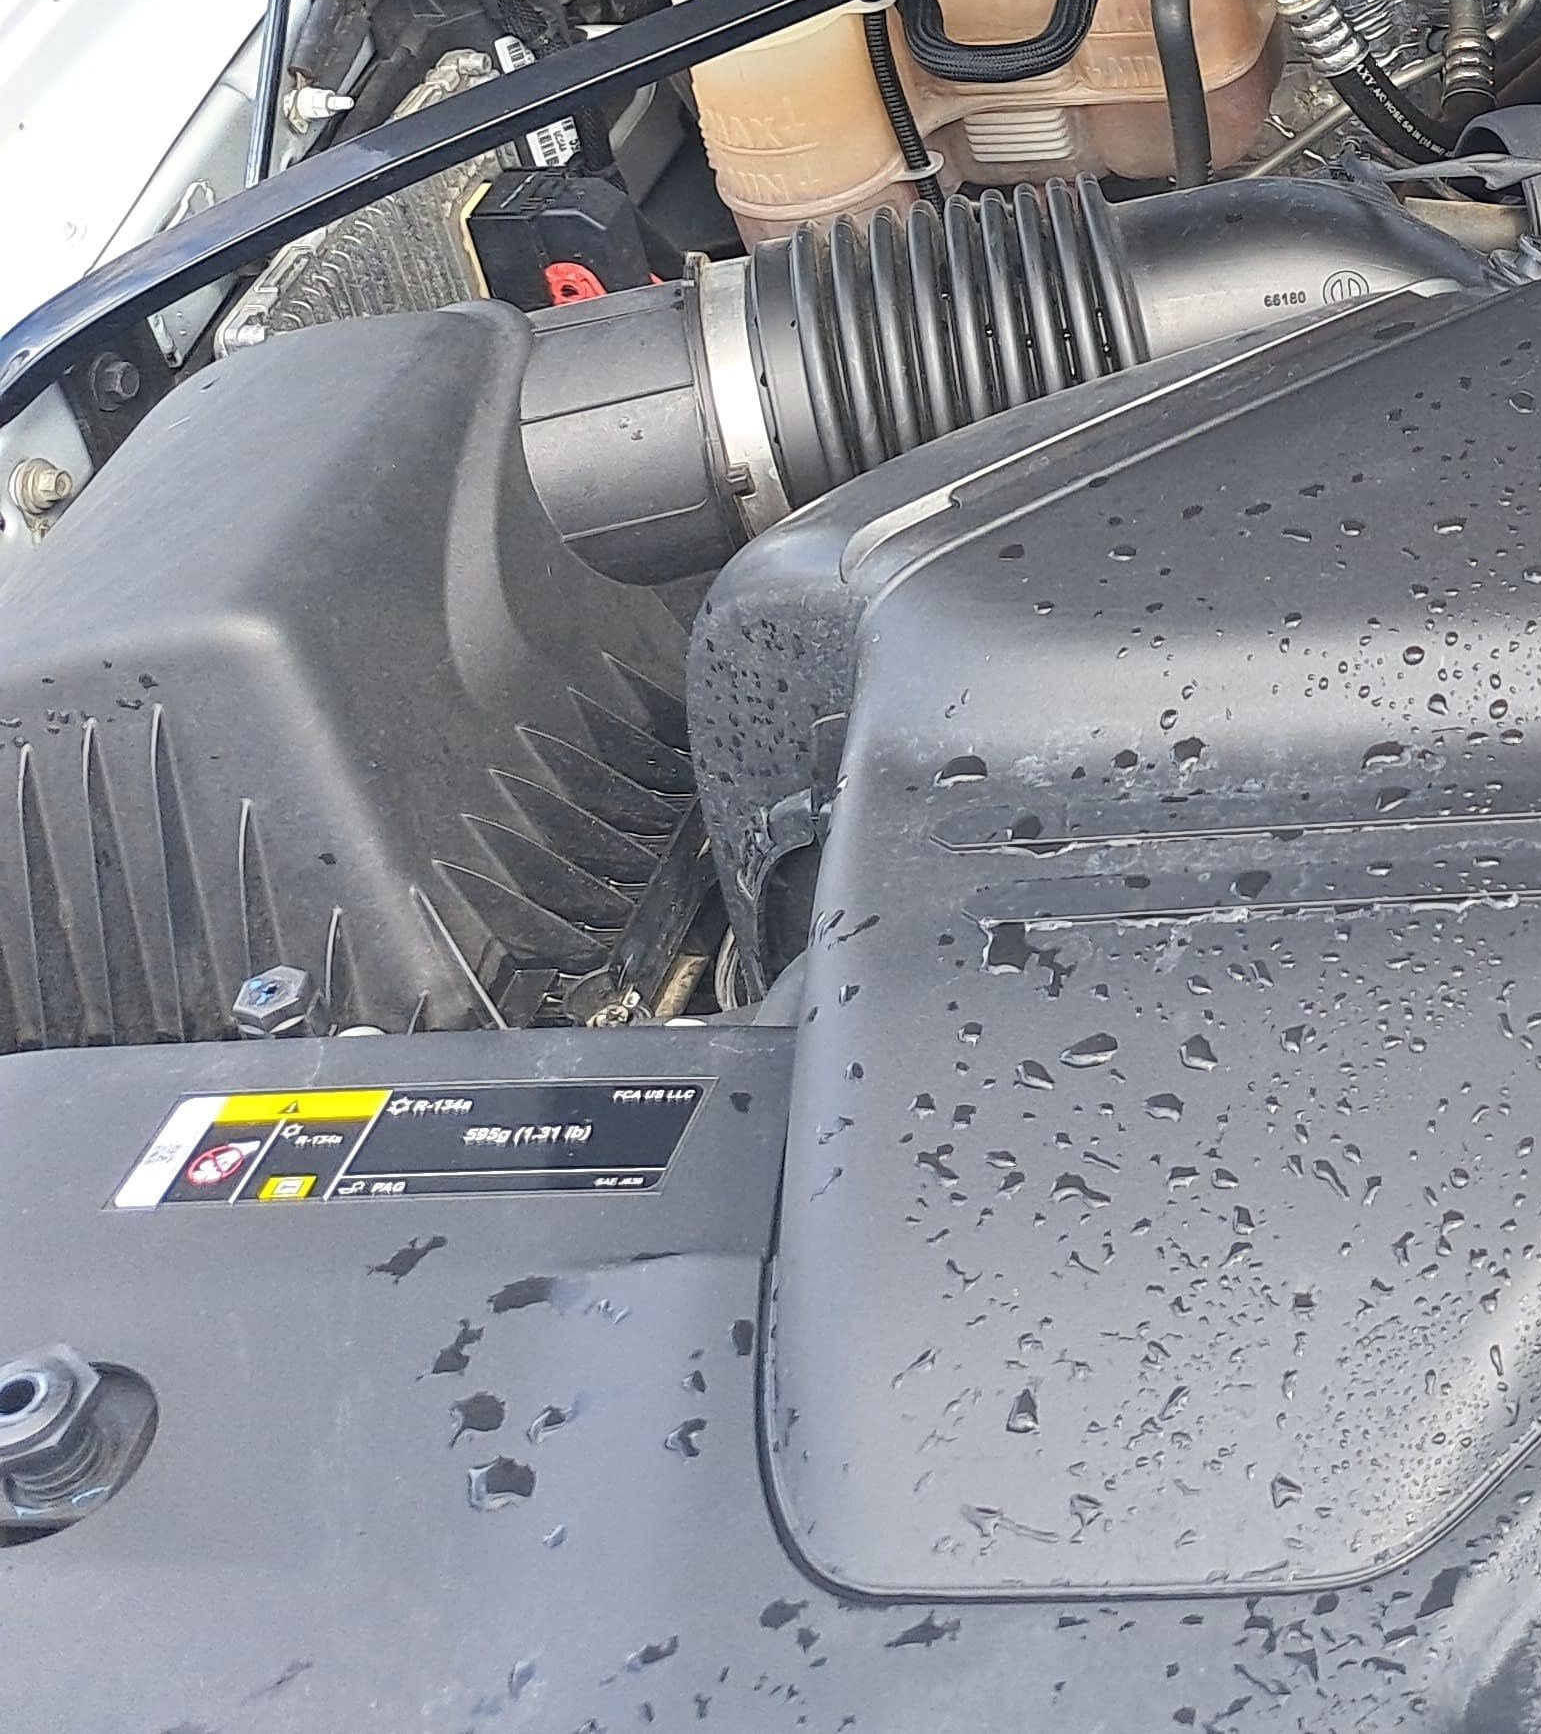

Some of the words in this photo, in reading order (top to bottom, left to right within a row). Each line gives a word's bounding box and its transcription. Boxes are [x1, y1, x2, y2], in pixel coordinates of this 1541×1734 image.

[613, 1089, 641, 1101] FCA
[667, 1088, 696, 1099] LLC
[413, 1097, 473, 1114] R-134a
[564, 1123, 592, 1141] lb)
